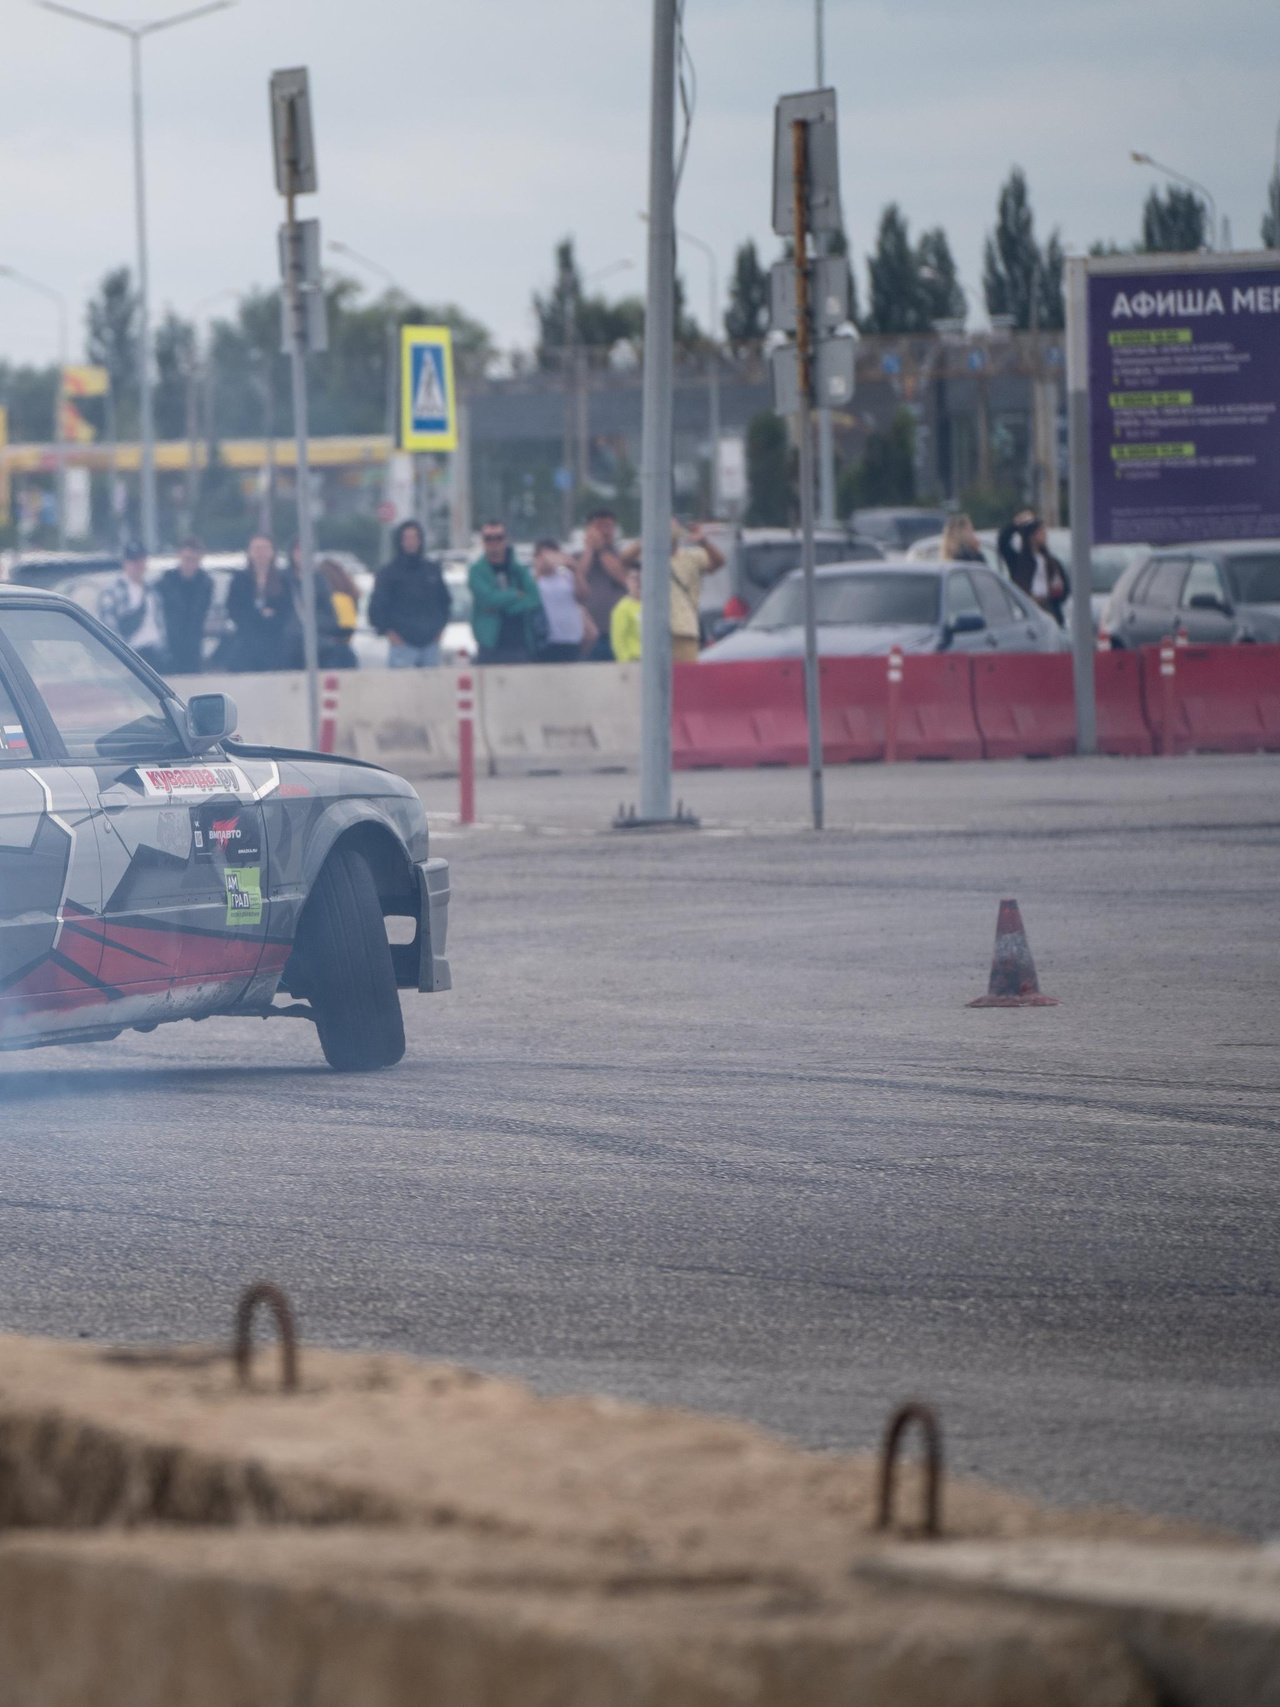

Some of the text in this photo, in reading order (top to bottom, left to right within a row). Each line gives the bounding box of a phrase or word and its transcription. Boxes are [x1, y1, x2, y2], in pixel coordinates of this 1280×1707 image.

[1111, 287, 1225, 318] АФИША
[146, 768, 240, 791] кувалда.ру
[228, 875, 239, 890] АМ
[231, 892, 250, 908] ГРАД
